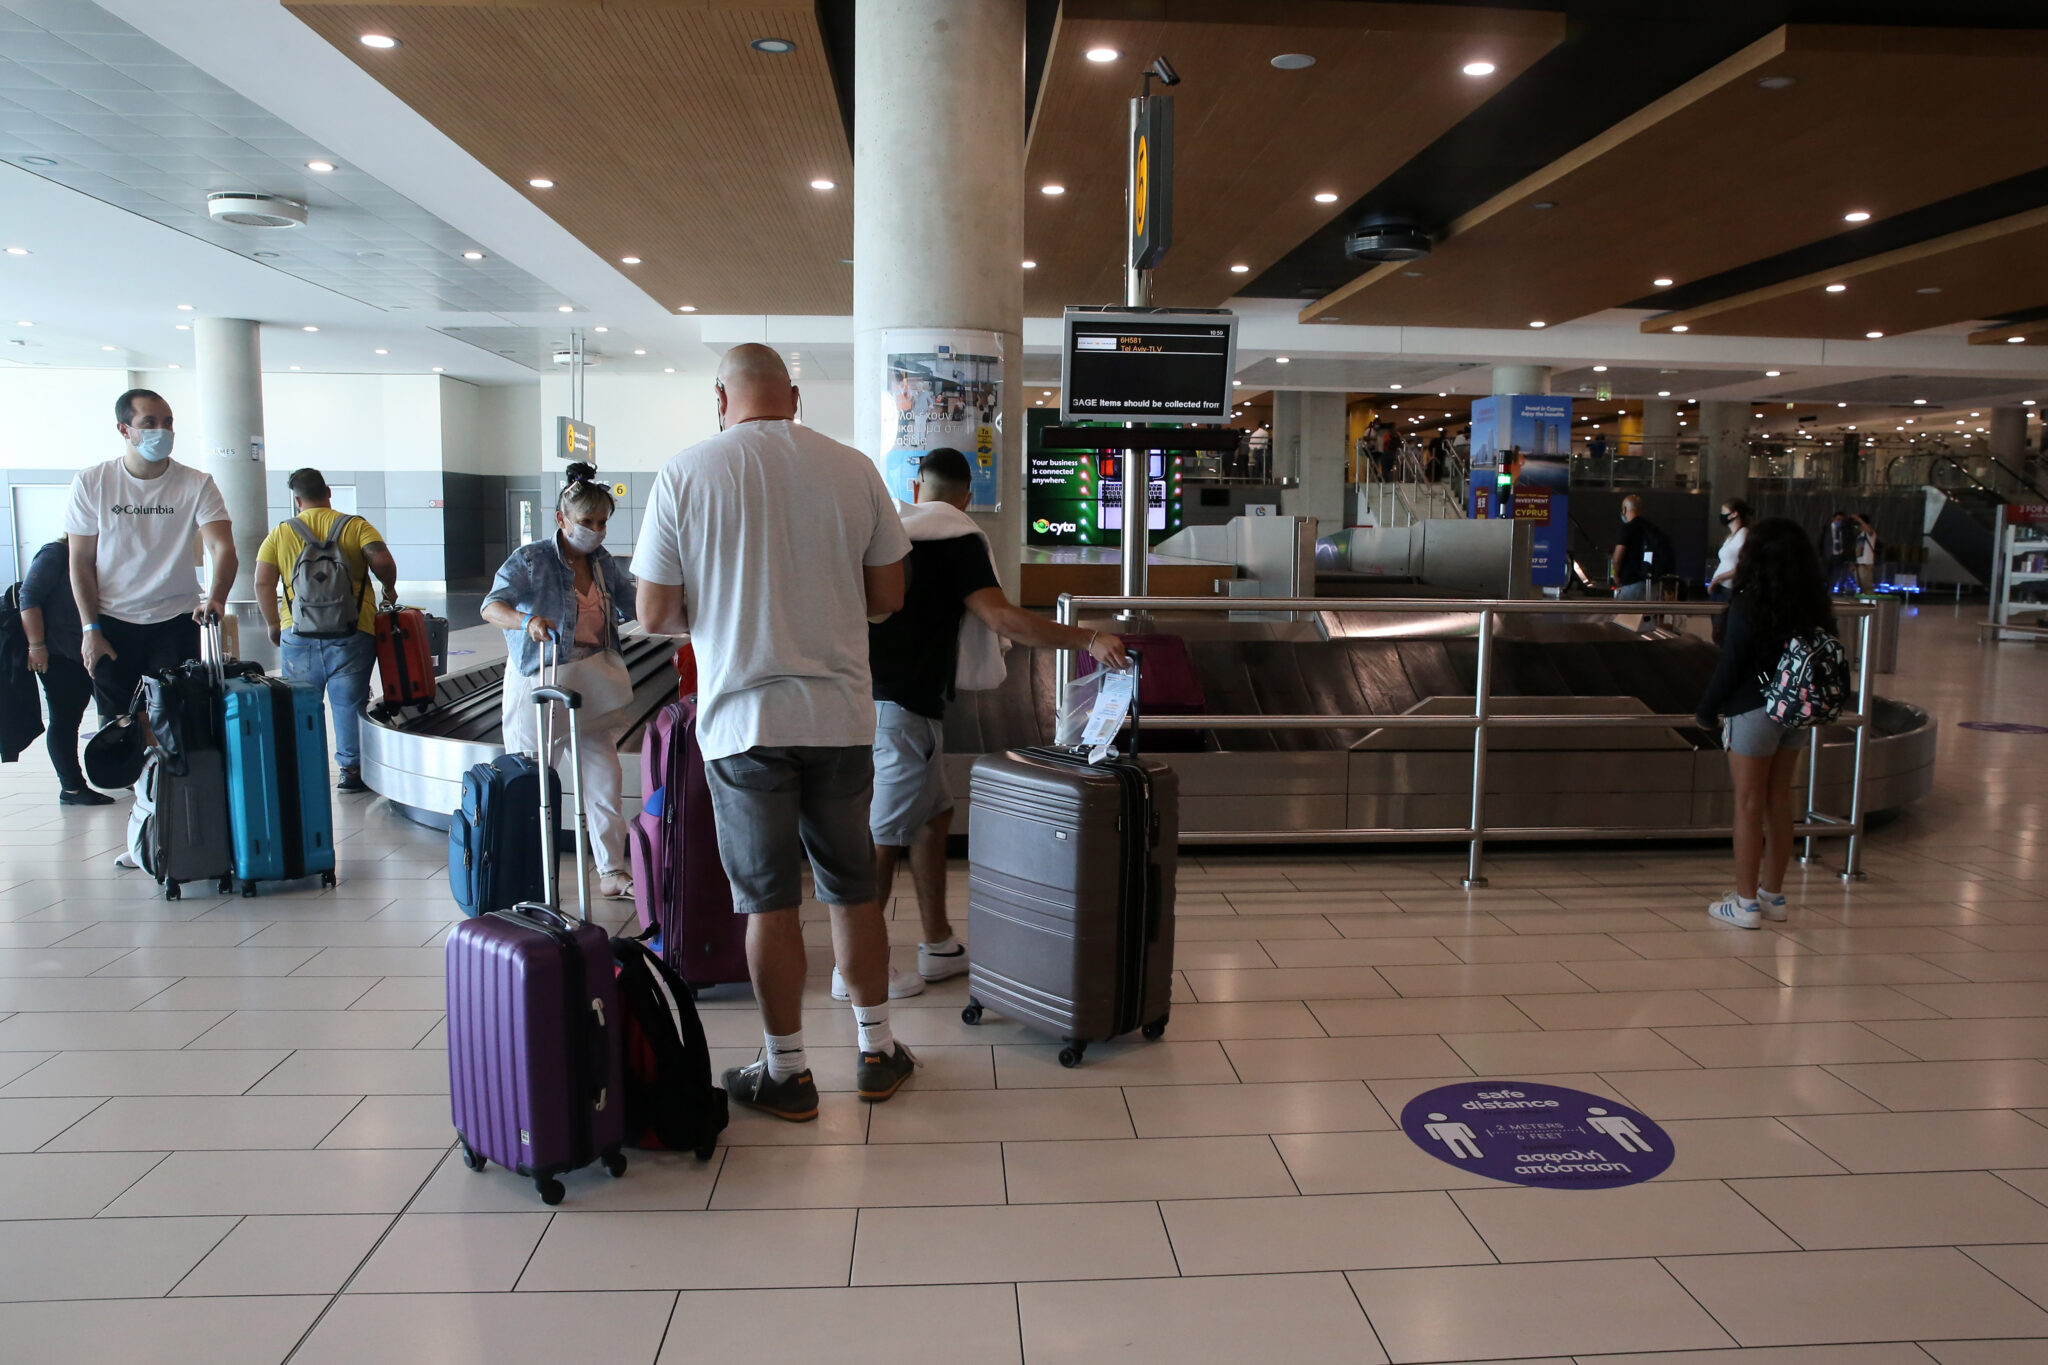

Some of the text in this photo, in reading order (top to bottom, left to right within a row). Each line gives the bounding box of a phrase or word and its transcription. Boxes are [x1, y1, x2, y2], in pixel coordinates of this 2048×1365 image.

[1072, 399, 1098, 407] GAGE
[1123, 400, 1150, 408] should
[1152, 400, 1162, 408] be
[1164, 400, 1201, 408] collected
[1049, 458, 1078, 466] business
[1032, 477, 1067, 485] anywhere.
[616, 485, 624, 495] 6
[124, 504, 175, 515] Columbia
[1515, 509, 1548, 517] CYPRUS
[1049, 521, 1077, 535] cyta
[1477, 1089, 1526, 1099] safe
[1462, 1100, 1560, 1110] distance
[1509, 1122, 1564, 1130] METERS
[1529, 1132, 1562, 1140] FEET
[1516, 1149, 1608, 1163] ασφαλή
[1514, 1162, 1632, 1175] απόσταση
